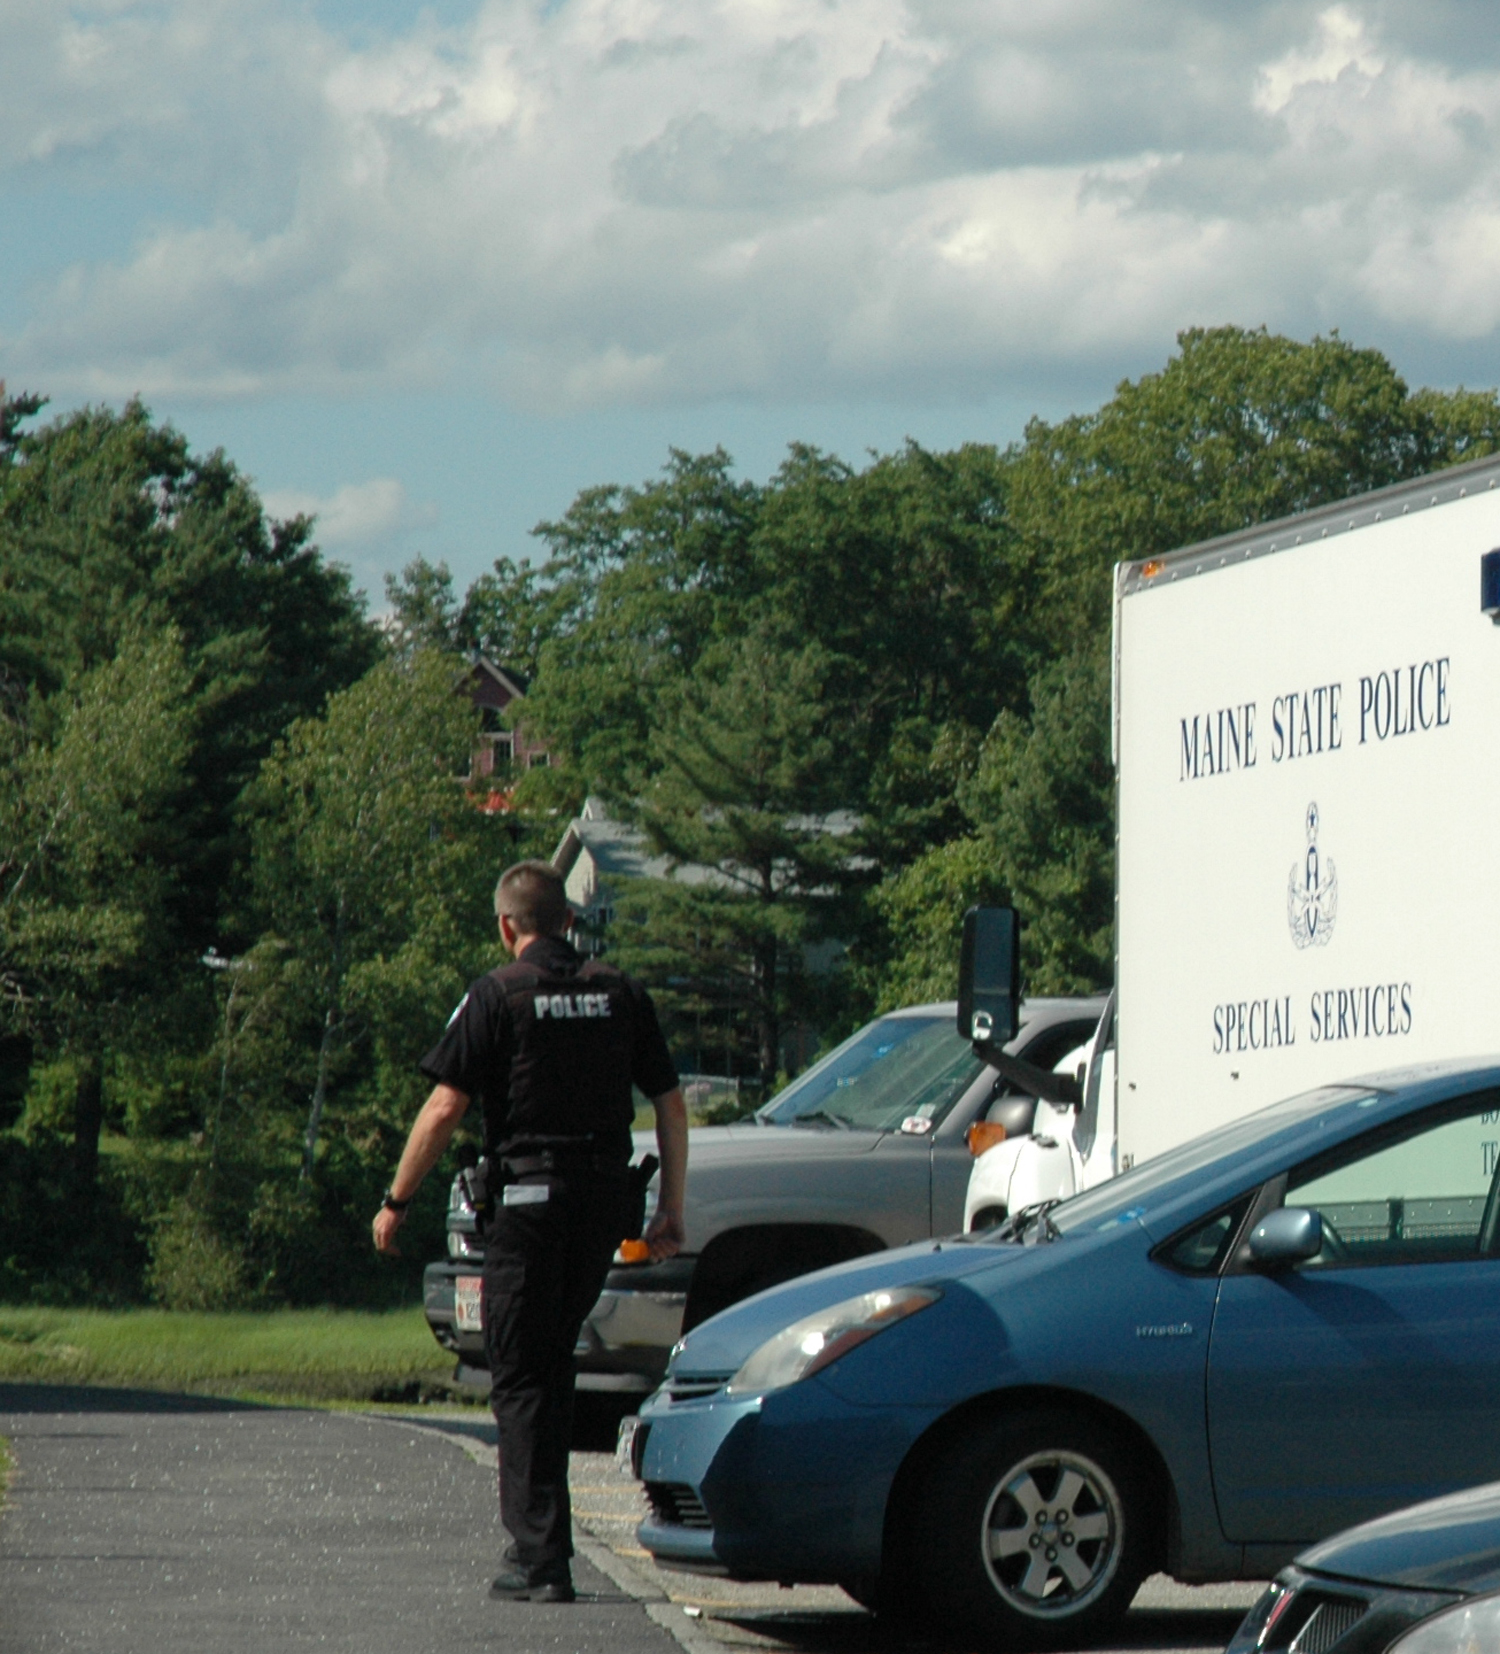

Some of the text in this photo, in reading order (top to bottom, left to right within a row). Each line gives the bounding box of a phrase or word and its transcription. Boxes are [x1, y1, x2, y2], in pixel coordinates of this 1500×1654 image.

[1179, 657, 1451, 781] MAINE STATE POLICE
[534, 993, 612, 1020] POLICE
[1212, 982, 1412, 1055] SPECIAL SERVICES
